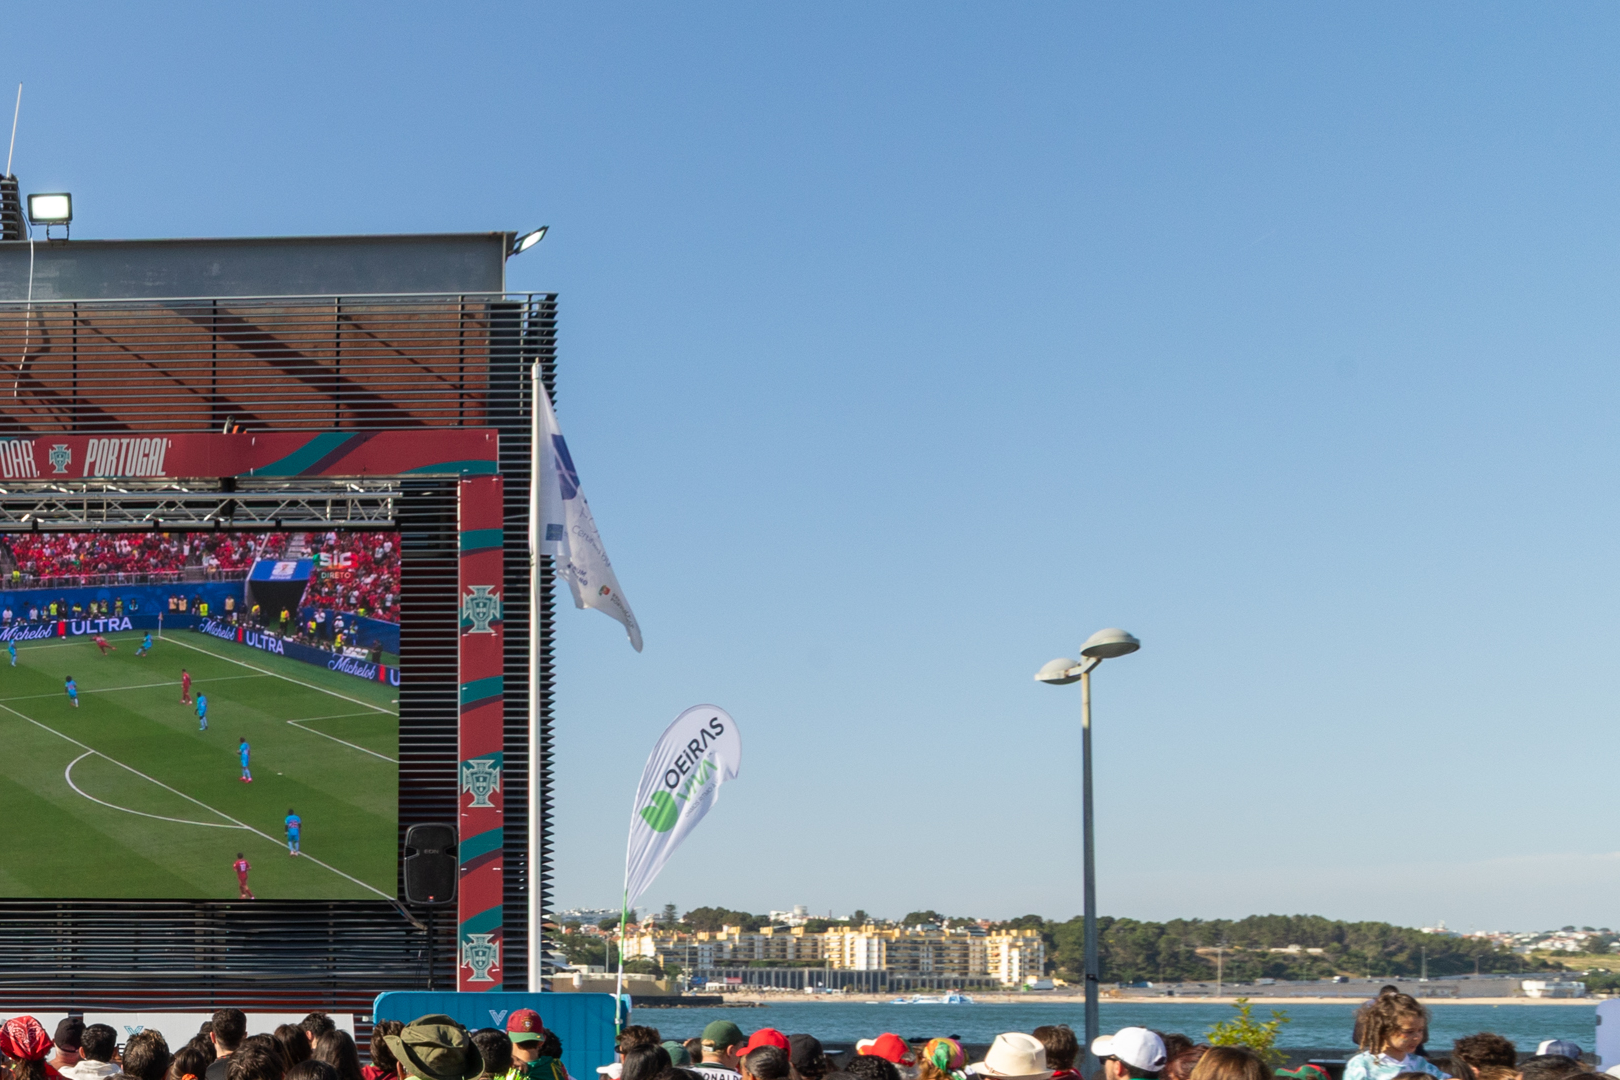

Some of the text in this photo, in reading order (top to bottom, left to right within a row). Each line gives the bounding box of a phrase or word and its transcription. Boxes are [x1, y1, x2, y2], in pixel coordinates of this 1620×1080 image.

[82, 438, 168, 477] PORTUGAL
[321, 571, 351, 580] DIRETO
[71, 616, 133, 635] ULTRA
[199, 618, 285, 655] Michelob ULTRA
[328, 654, 376, 680] Michelob
